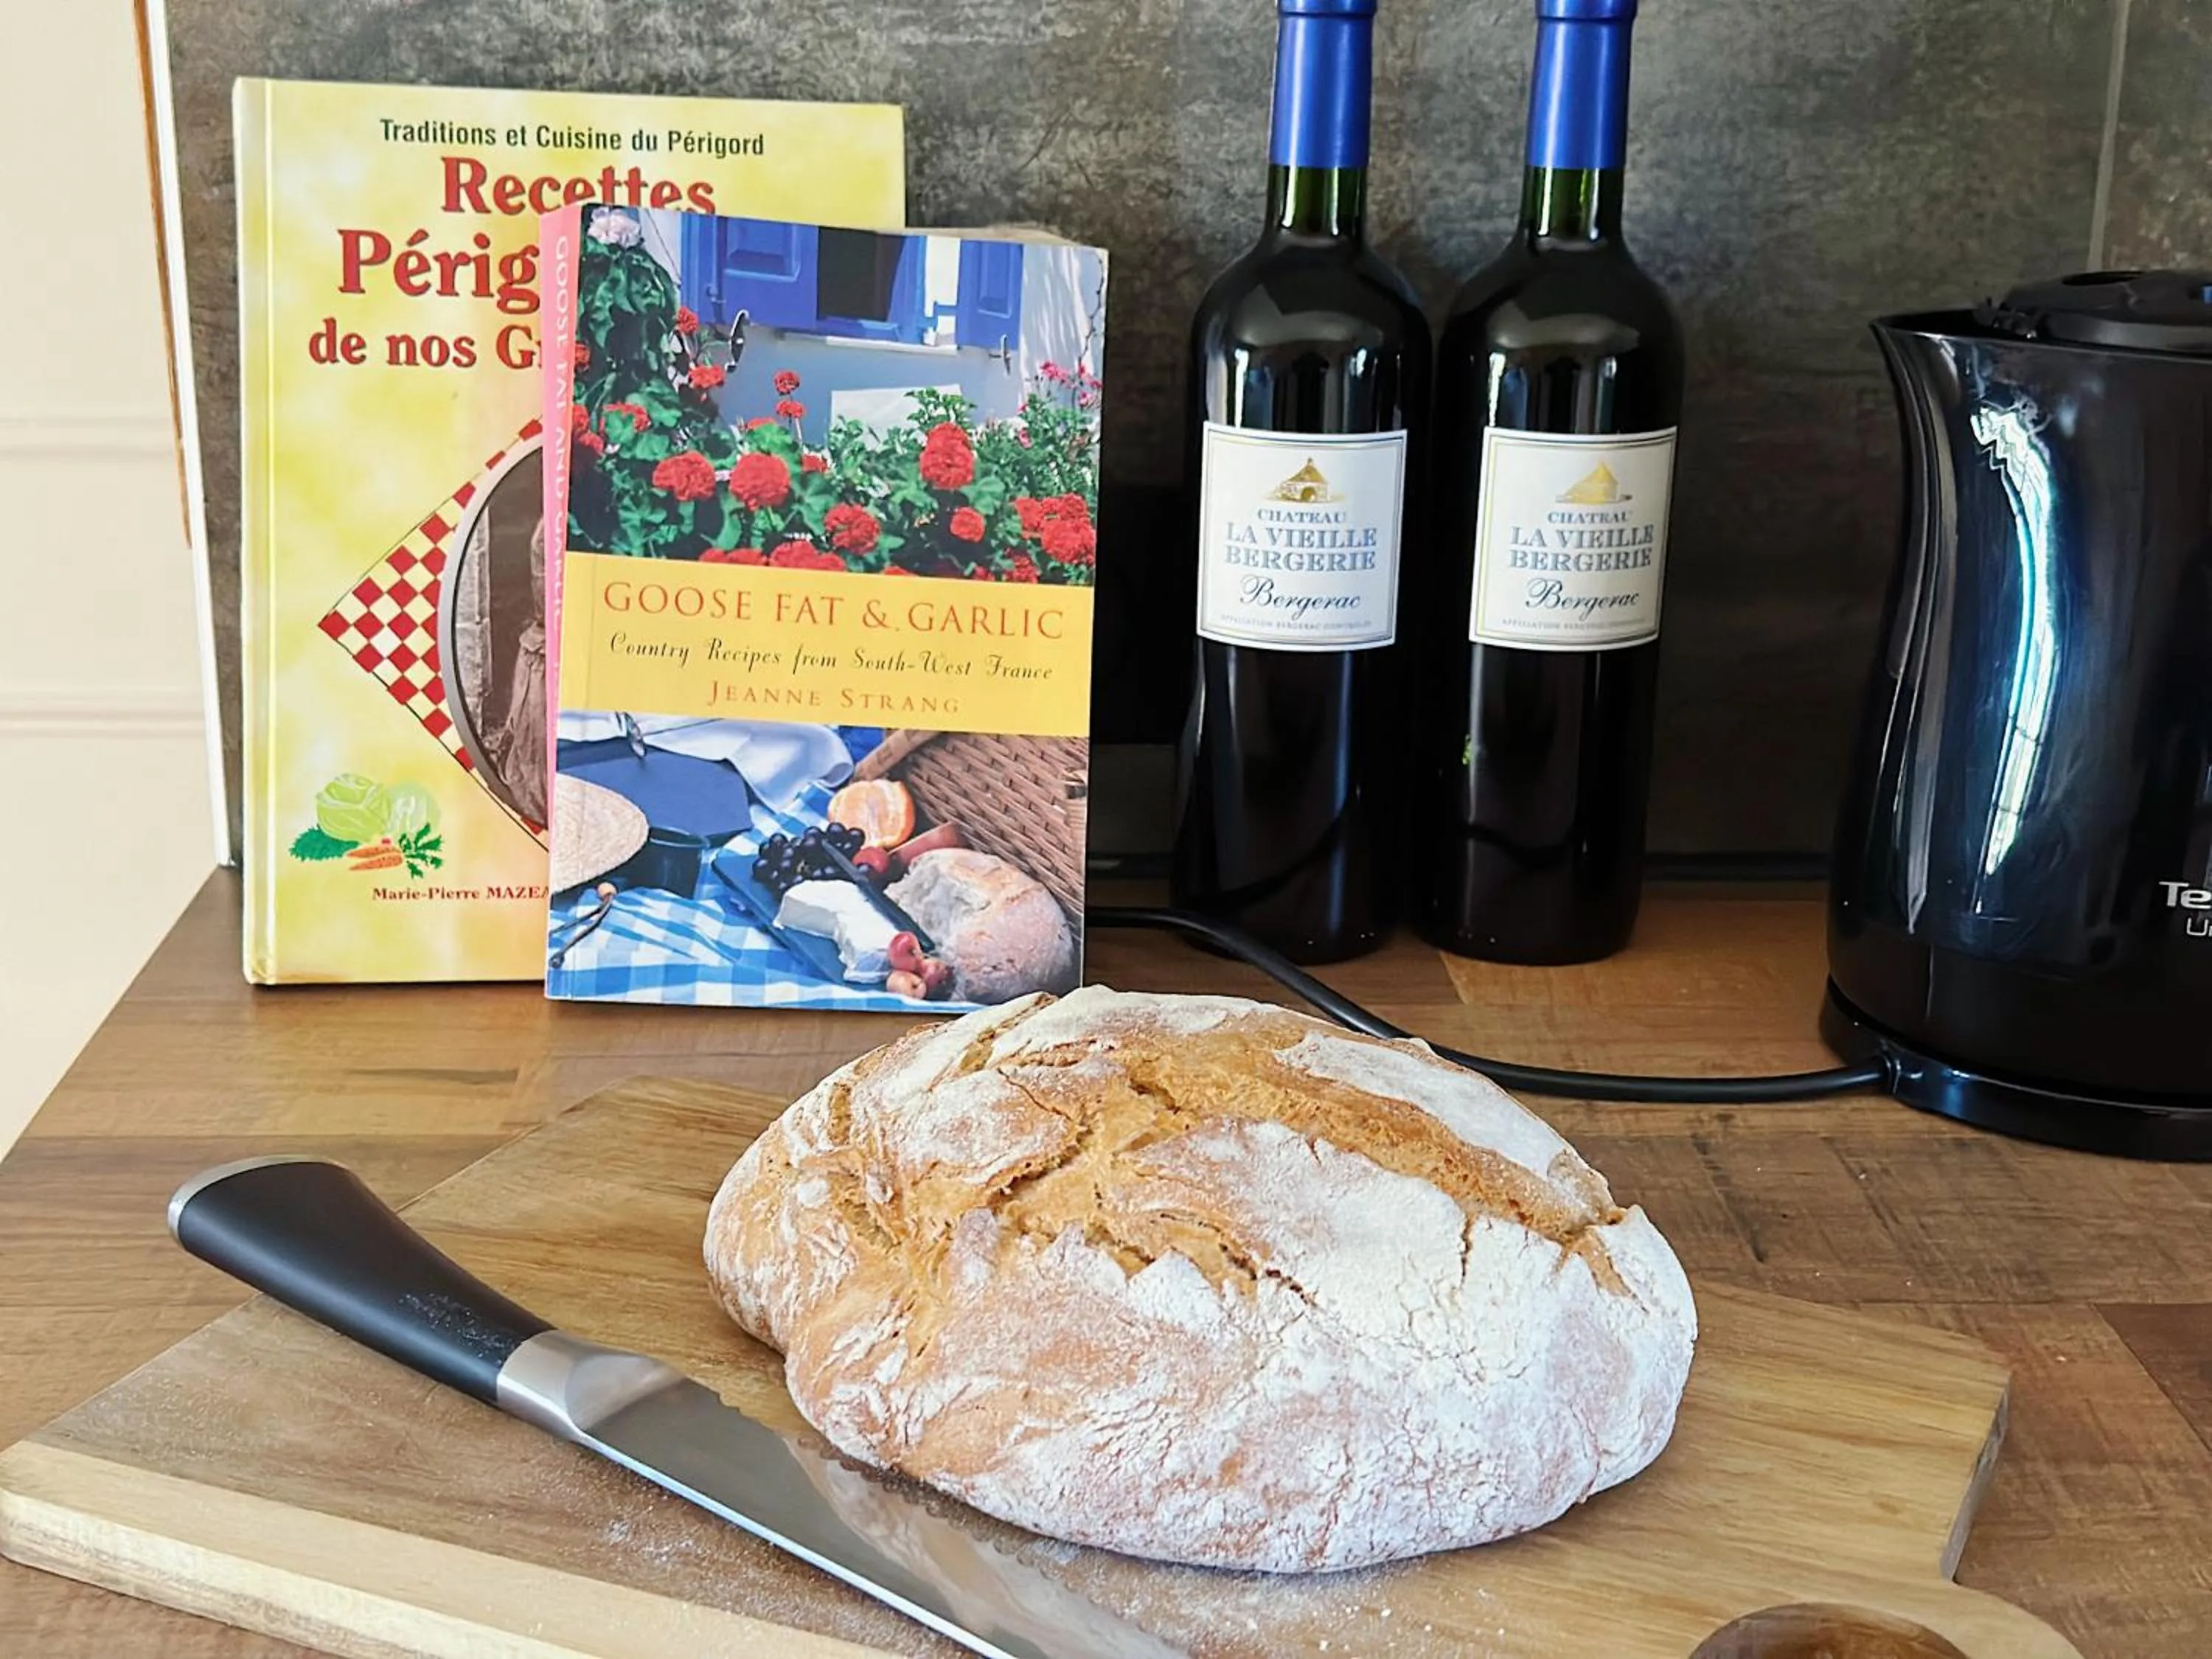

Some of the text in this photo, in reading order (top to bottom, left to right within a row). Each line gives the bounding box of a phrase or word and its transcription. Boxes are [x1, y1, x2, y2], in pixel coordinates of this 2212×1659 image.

[380, 119, 764, 159] Traditions et Cuisine du Périgord
[440, 156, 716, 215] Recettes
[309, 318, 542, 369] de nos G
[1226, 522, 1377, 549] LA VIEILLE
[1510, 524, 1654, 549] LA VIEILLE
[1224, 545, 1376, 571] BERGERIE
[1509, 548, 1652, 572] BERGERIE
[604, 581, 1063, 639] GOOSE FAT & GARLIC
[1239, 574, 1360, 621] Bergerac
[1526, 577, 1639, 621] Bergerac
[610, 631, 1053, 680] Country Recipes from South-West France
[707, 680, 959, 714] JEANNE STRANG
[372, 887, 479, 900] Marie-Pierre
[2158, 881, 2212, 909] Te
[2186, 918, 2212, 936] U
